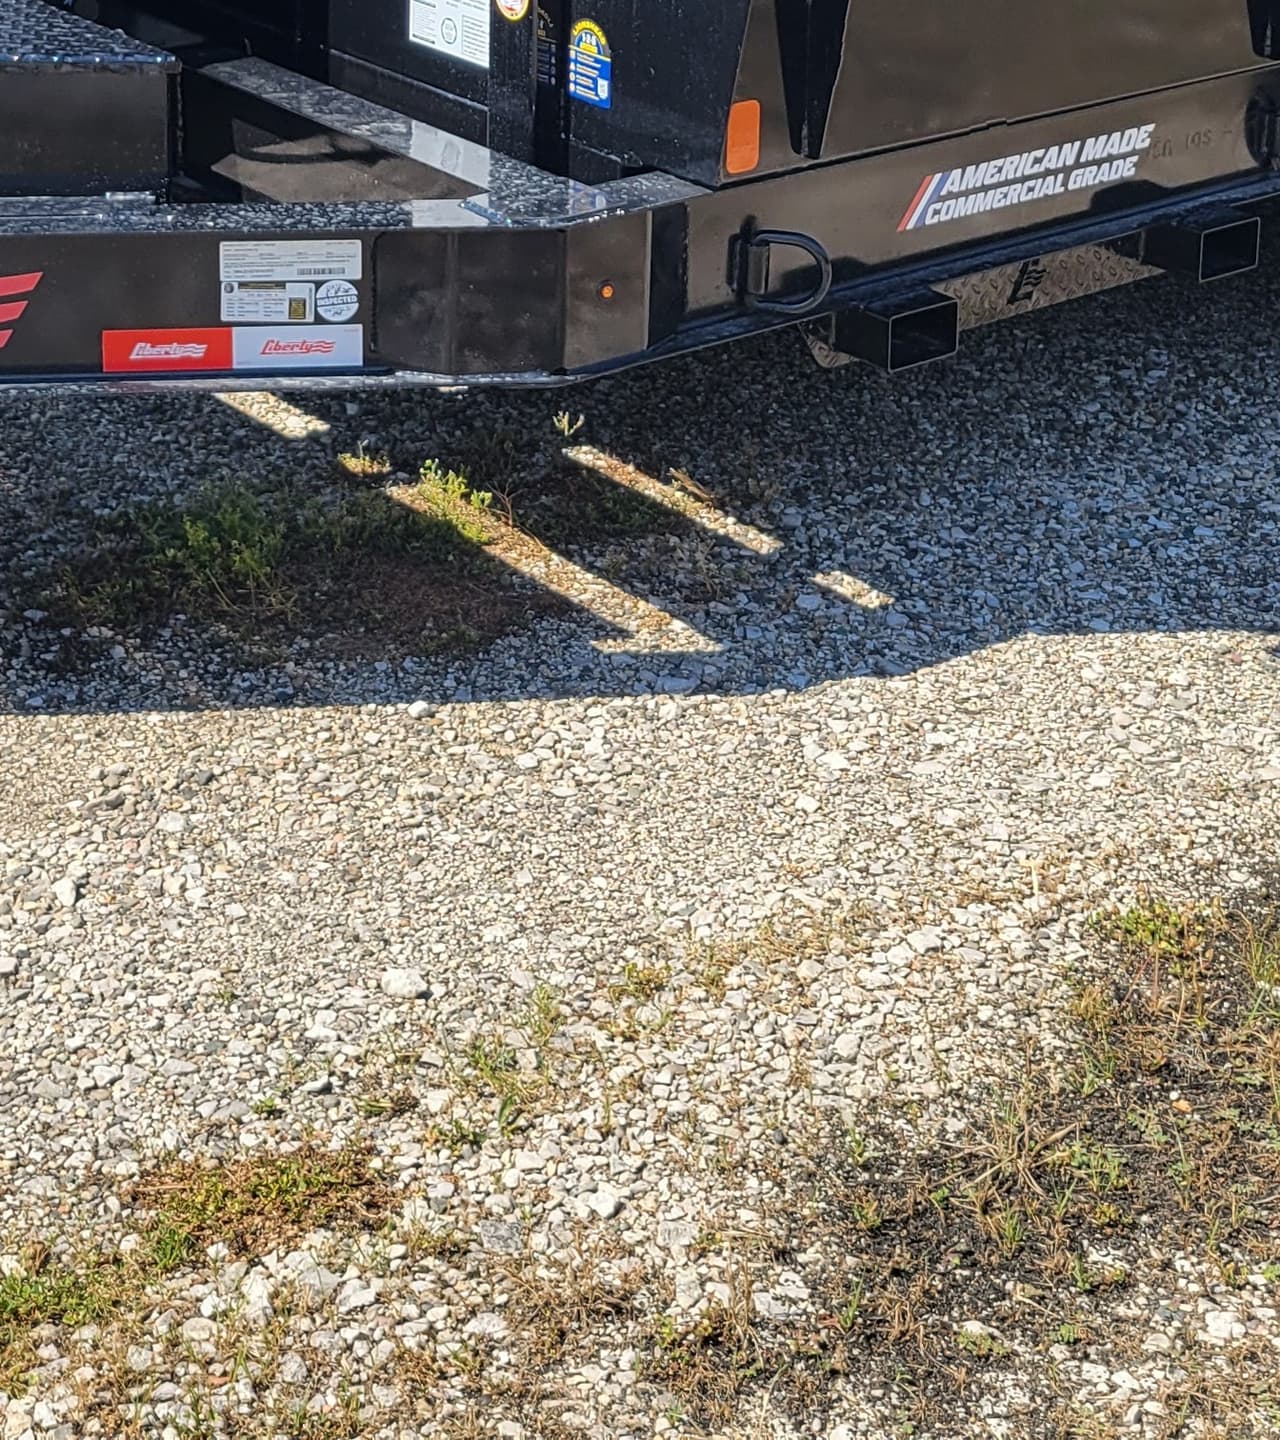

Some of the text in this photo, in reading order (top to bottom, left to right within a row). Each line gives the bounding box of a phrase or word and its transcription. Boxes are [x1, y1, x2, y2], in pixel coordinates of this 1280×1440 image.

[924, 156, 1139, 226] COMMERCIAL GRADE
[940, 141, 1083, 197] AMERICAN
[1080, 123, 1156, 163] MADE
[260, 339, 314, 356] Liberty
